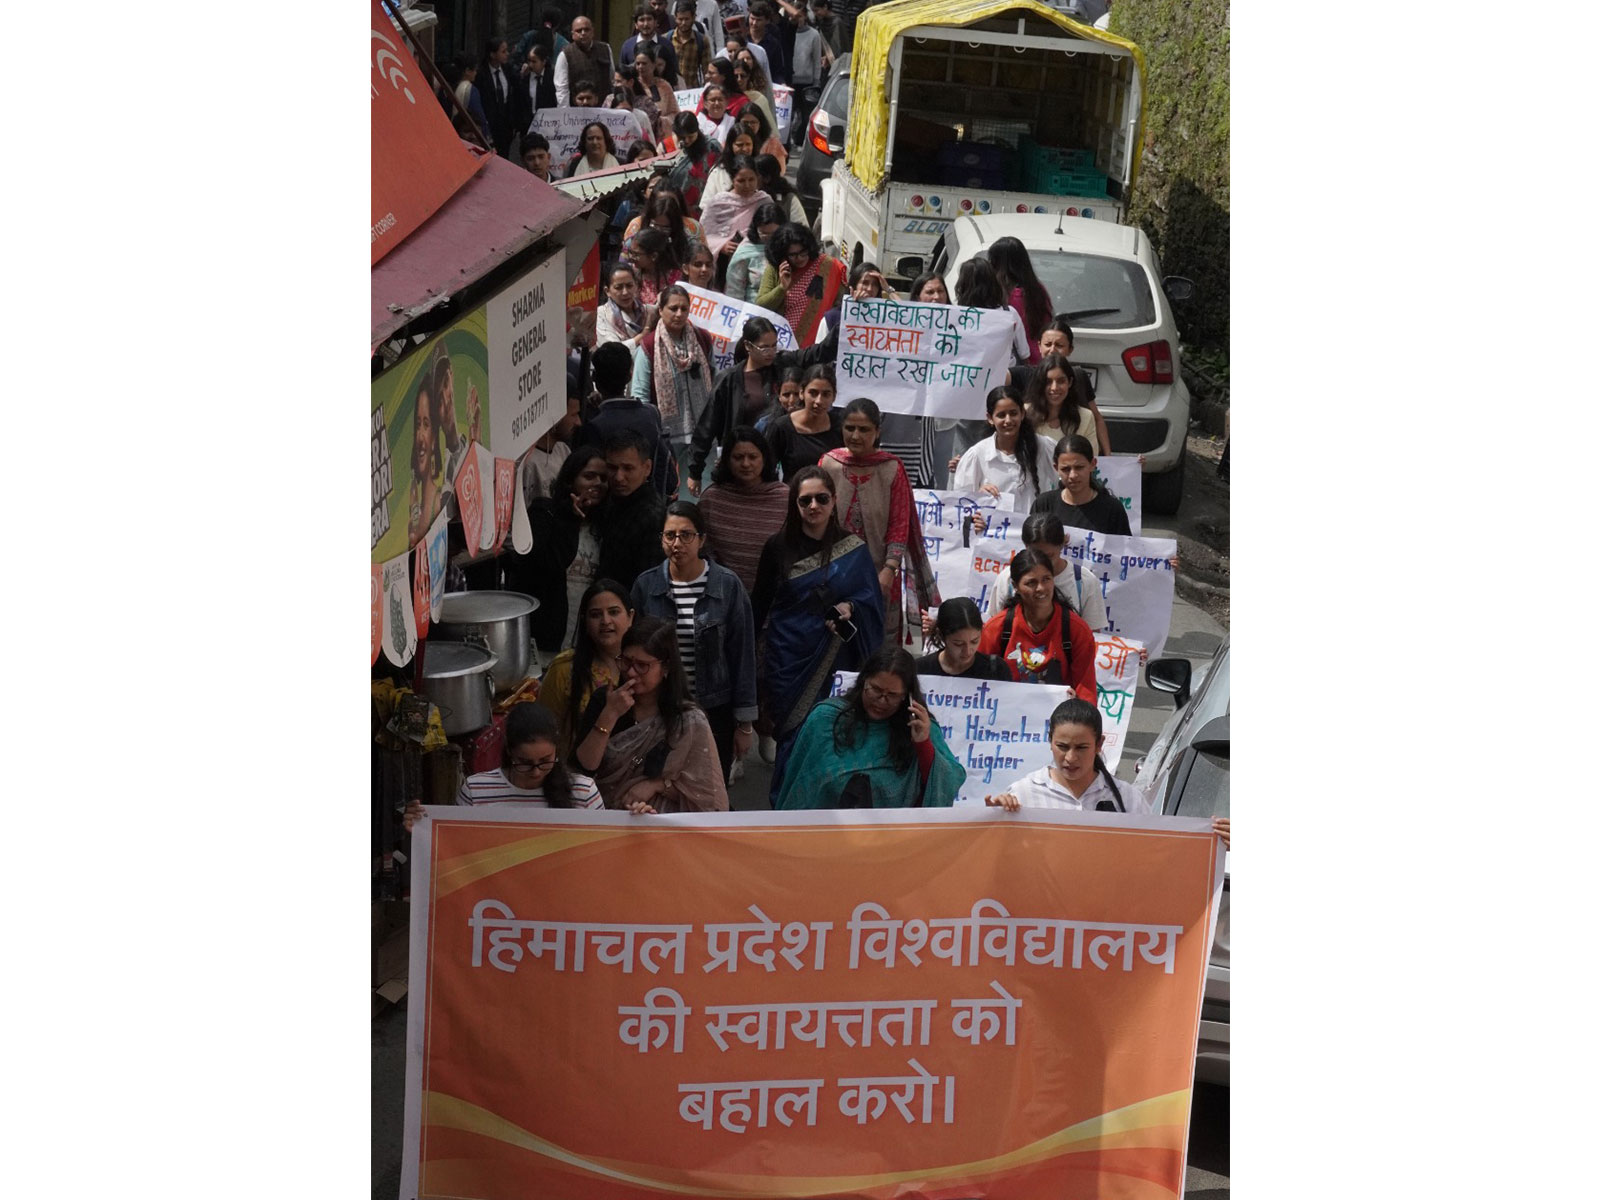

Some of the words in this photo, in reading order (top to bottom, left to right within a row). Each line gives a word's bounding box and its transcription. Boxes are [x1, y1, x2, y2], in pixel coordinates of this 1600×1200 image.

[512, 282, 545, 328] SHARMA
[844, 297, 951, 331] विश्वविद्यालय
[958, 307, 985, 331] की
[512, 320, 547, 367] GENERAL
[935, 324, 961, 356] को
[518, 360, 542, 401] STORE
[841, 352, 890, 379] बहाल
[897, 358, 938, 385] रखा
[984, 515, 1011, 540] Let
[1063, 532, 1111, 564] rsities
[924, 681, 998, 726] iversity
[968, 743, 1024, 784] higher
[468, 899, 692, 974] हिमाचल
[702, 903, 833, 973] प्रदेश
[847, 898, 1184, 974] विश्वविद्यालय
[618, 986, 692, 1053] की
[705, 1000, 937, 1052] स्वायत्तता
[951, 980, 1022, 1046] को
[678, 1079, 824, 1134] बहाल
[838, 1058, 954, 1124] करो।
